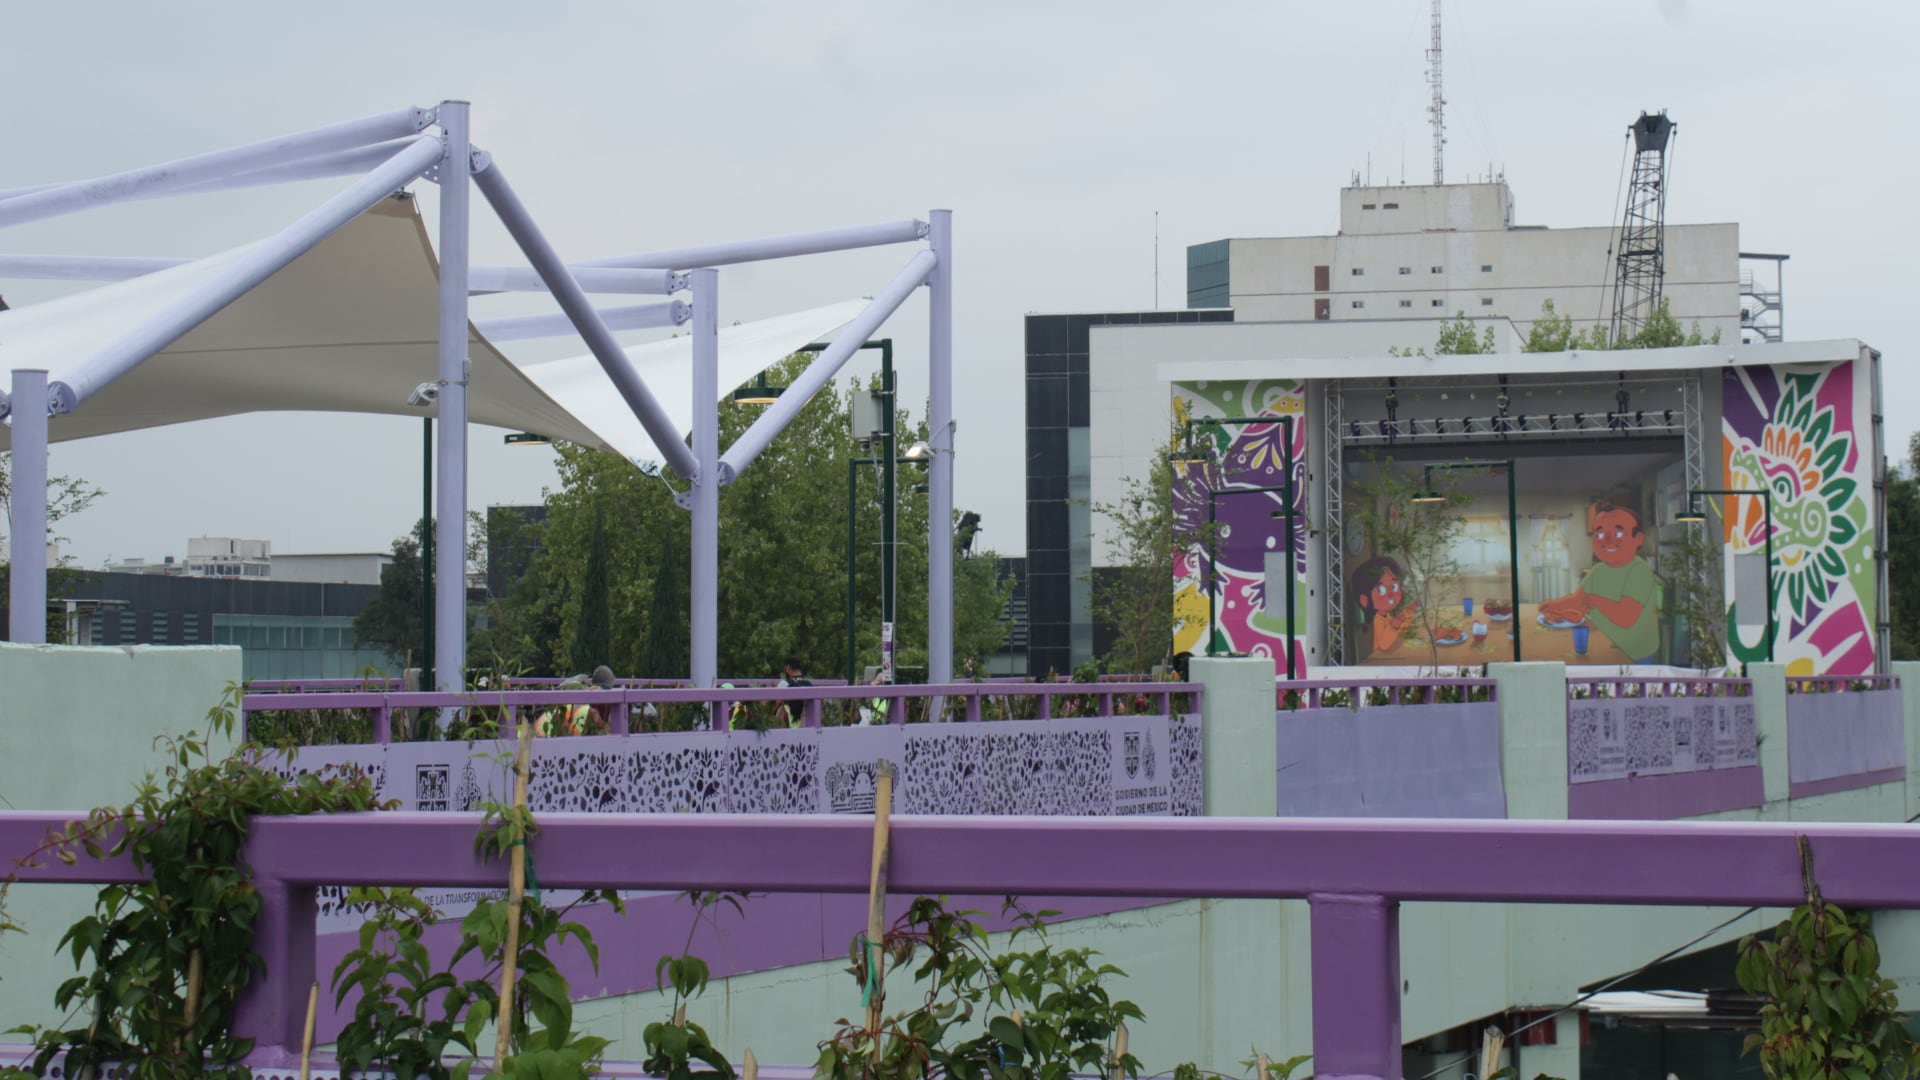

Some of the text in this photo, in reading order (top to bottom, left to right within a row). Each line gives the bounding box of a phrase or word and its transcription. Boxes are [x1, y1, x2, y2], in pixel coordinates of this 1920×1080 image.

[1149, 786, 1157, 797] DE
[1159, 785, 1167, 797] LA
[1137, 803, 1145, 814] DE
[424, 895, 434, 906] DE
[435, 894, 445, 906] LA
